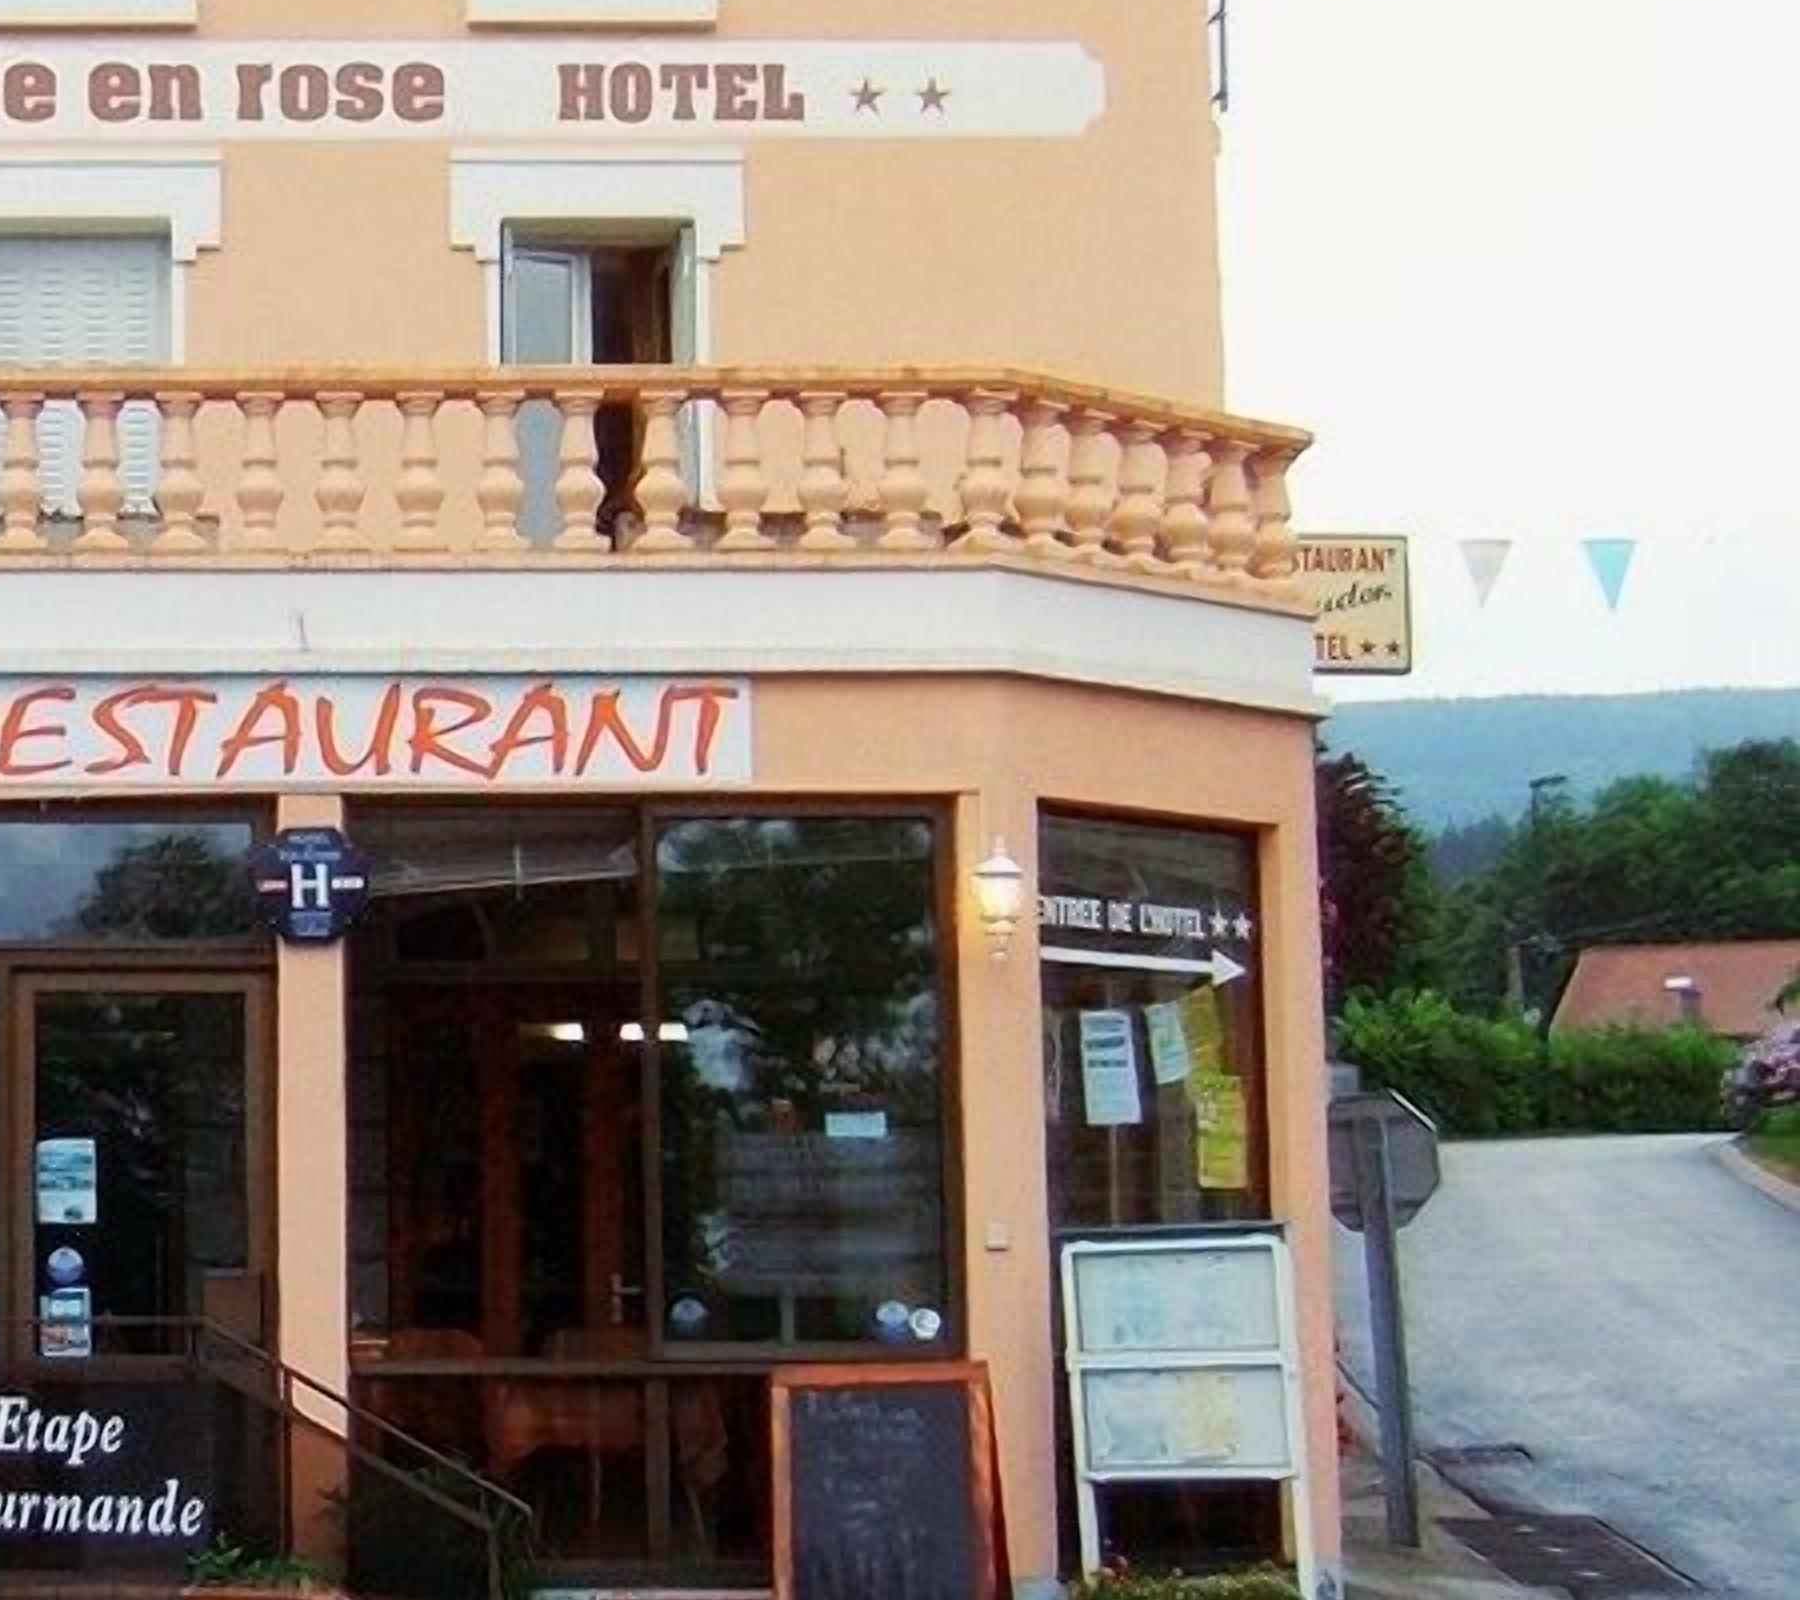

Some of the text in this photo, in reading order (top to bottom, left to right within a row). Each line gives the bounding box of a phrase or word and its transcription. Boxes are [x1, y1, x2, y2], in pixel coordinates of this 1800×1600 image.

[88, 61, 203, 122] en
[236, 61, 446, 122] rose
[557, 61, 805, 123] HOTEL
[1301, 547, 1396, 572] TAURANT
[1313, 633, 1352, 661] TEL
[291, 863, 330, 909] H
